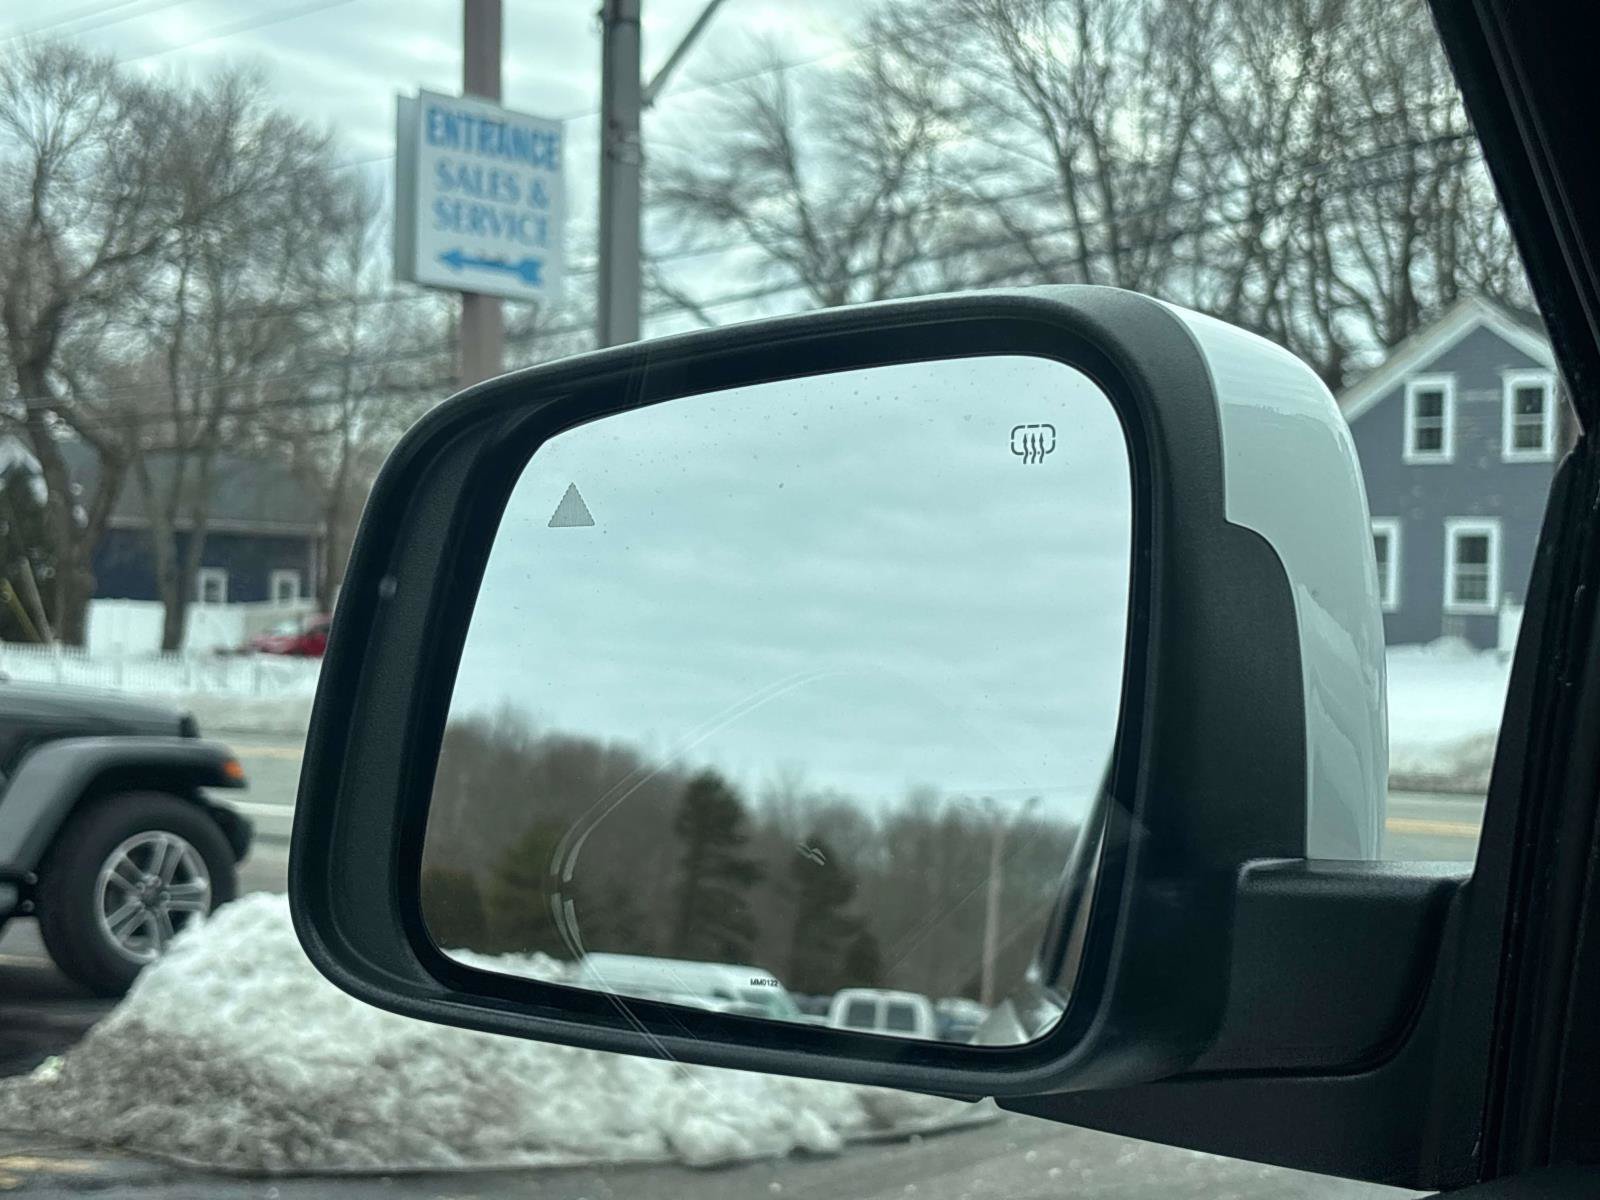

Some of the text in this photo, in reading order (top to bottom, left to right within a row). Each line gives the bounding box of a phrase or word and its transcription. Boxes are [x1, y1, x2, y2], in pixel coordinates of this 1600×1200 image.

[427, 106, 560, 171] ENTRANCE
[435, 159, 548, 211] SALES &
[434, 198, 549, 248] SERVICE
